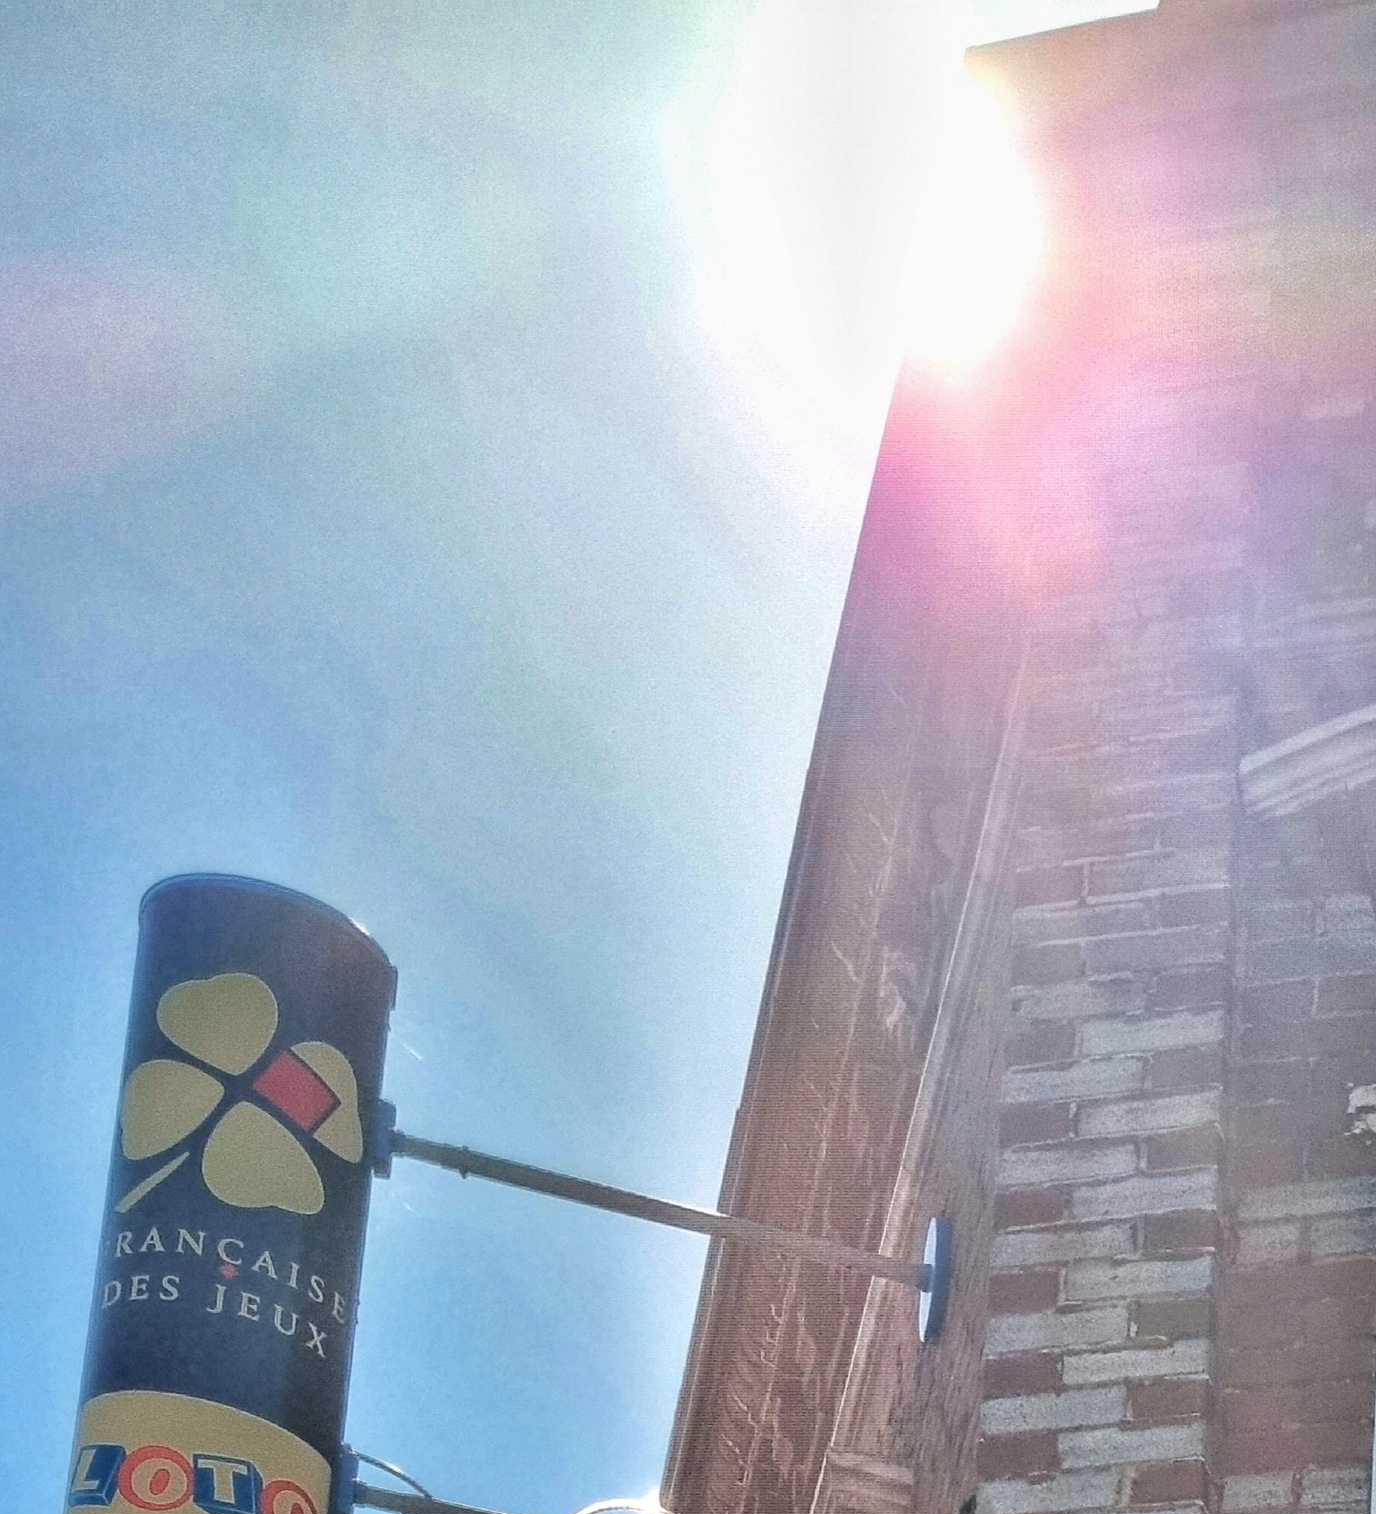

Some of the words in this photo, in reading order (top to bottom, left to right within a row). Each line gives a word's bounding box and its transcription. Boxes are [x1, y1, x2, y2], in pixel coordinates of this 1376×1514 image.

[101, 1275, 180, 1308] DES
[206, 1285, 326, 1357] JEUX
[105, 1227, 347, 1323] RANÇAISE
